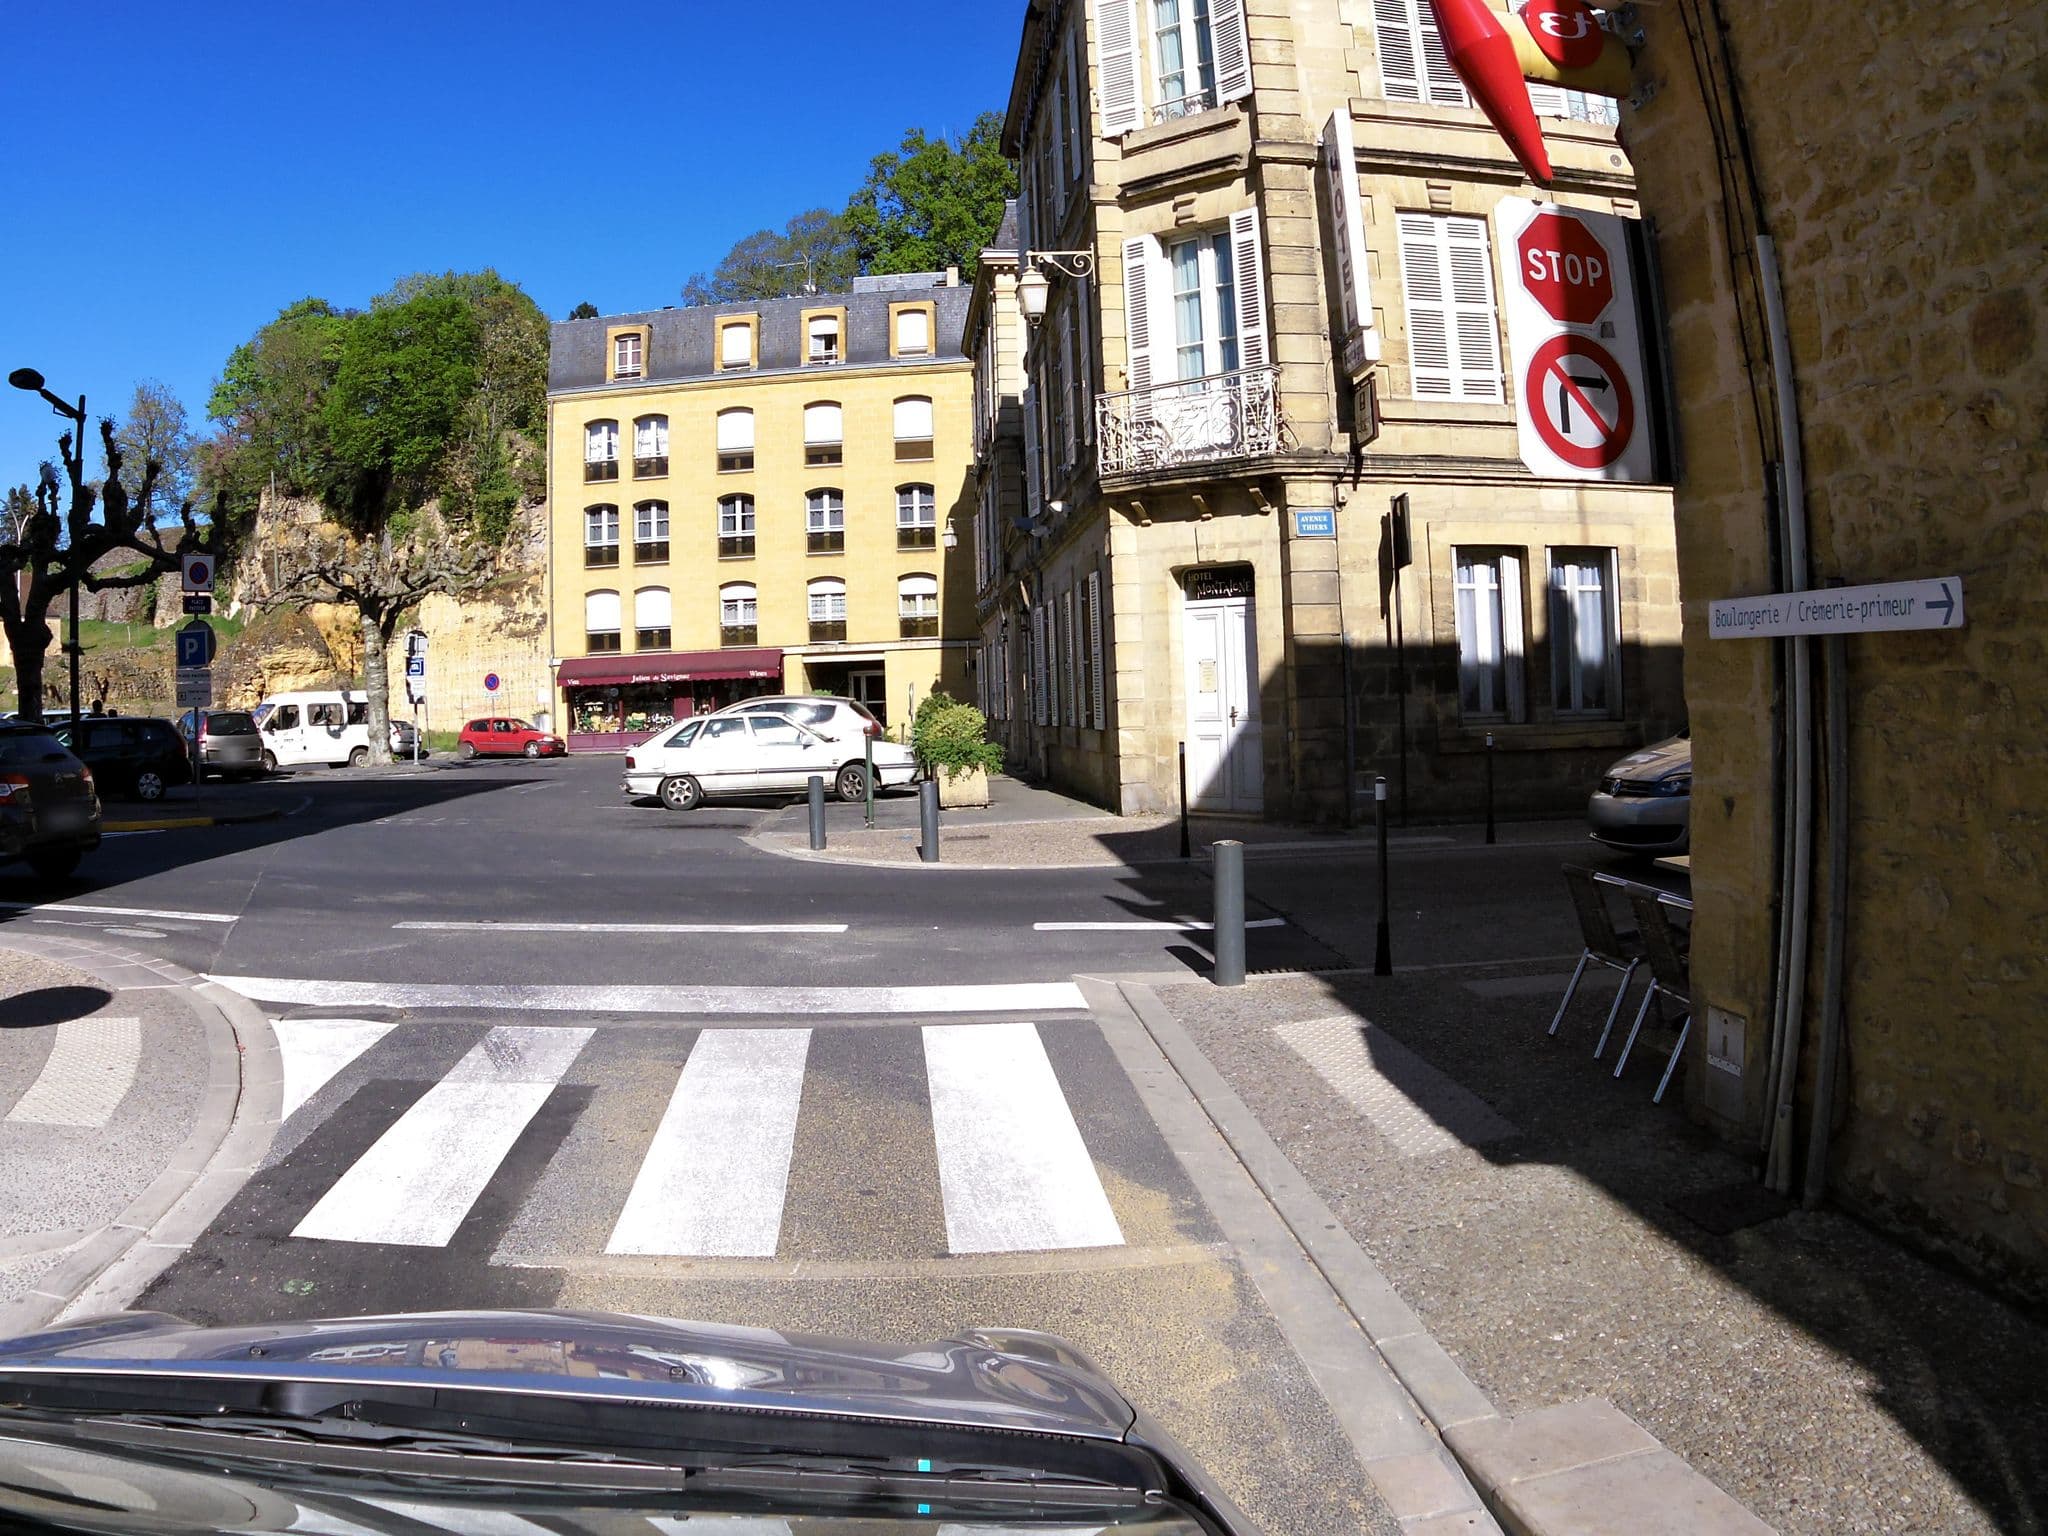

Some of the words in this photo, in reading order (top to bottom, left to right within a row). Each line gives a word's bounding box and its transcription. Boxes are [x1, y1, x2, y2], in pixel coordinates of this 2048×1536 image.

[1329, 150, 1357, 330] HOTEL
[1527, 248, 1604, 288] STOP
[1302, 523, 1329, 531] THIERS
[1187, 572, 1213, 581] HOTEL
[1197, 579, 1253, 599] MONTAIGNE
[1715, 603, 1780, 631] Boulangerie
[1785, 602, 1792, 622] /
[1798, 594, 1915, 624] Crèmerie-primeur
[185, 638, 199, 660] P
